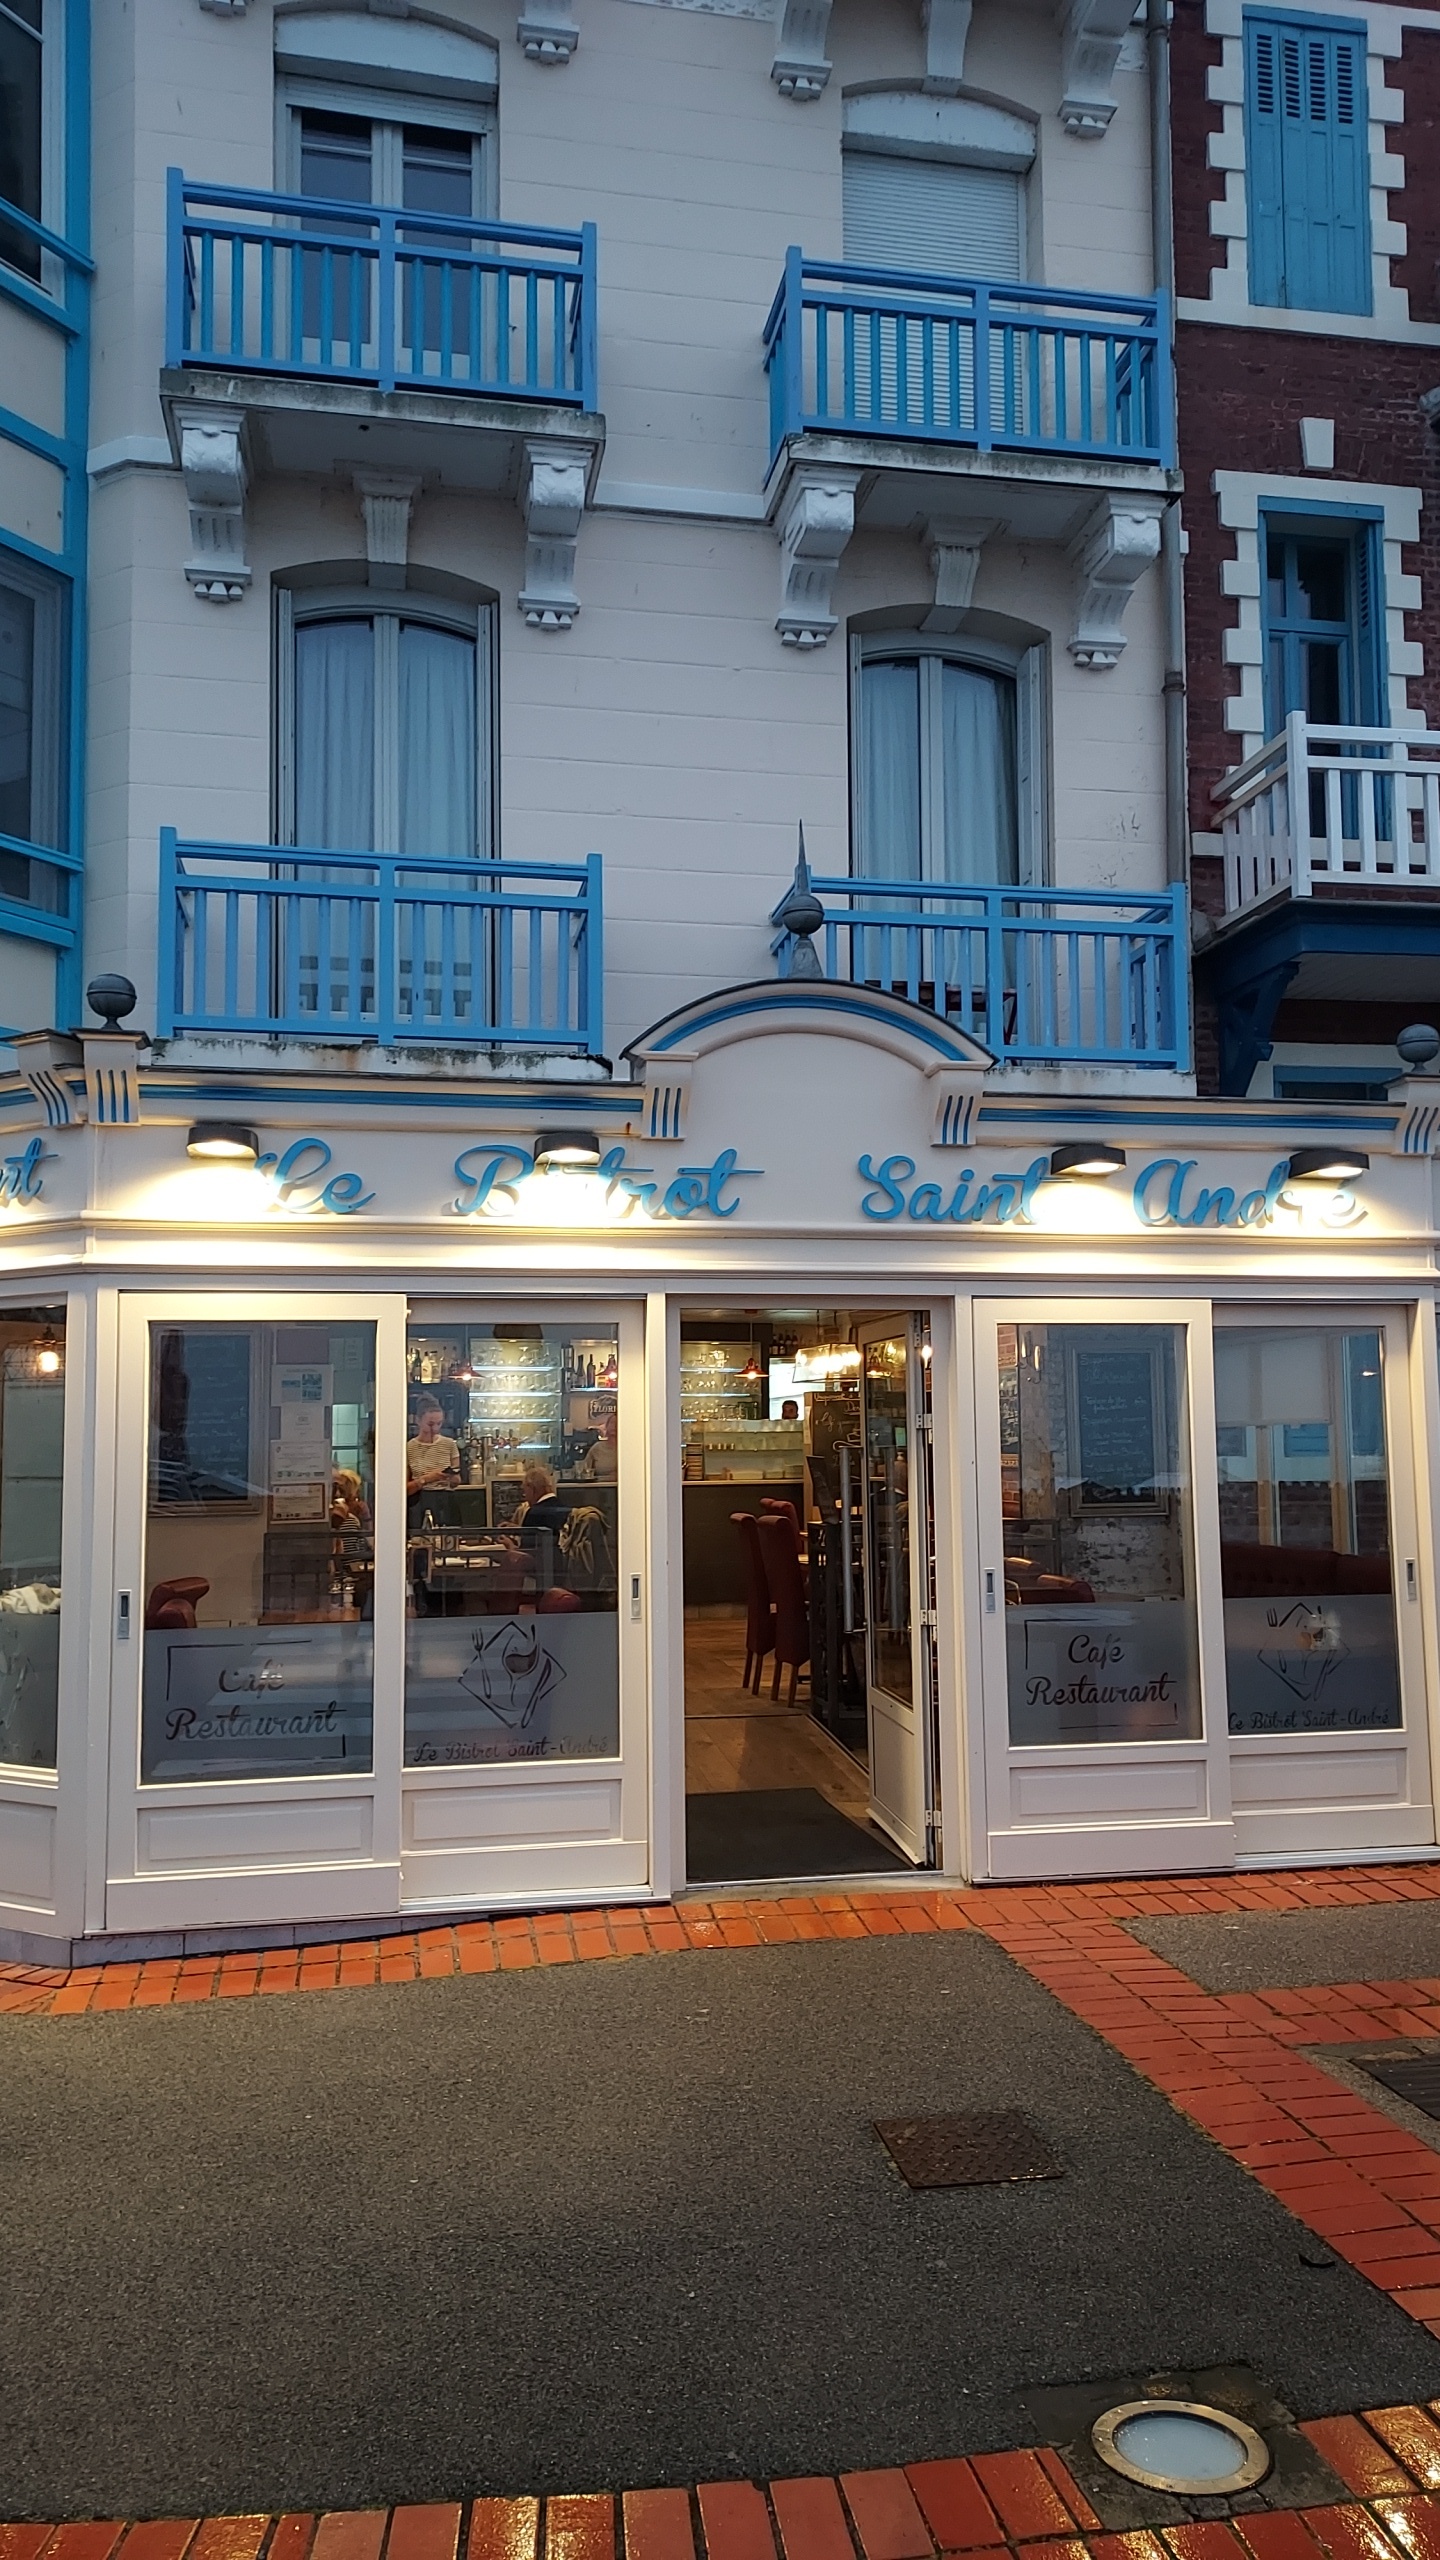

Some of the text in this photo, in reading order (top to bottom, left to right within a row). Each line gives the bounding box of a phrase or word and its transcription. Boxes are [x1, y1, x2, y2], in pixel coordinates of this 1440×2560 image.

[253, 1137, 1369, 1227] Le Btrot Saint Andé
[1068, 1633, 1125, 1670] Café
[218, 1659, 285, 1699] Café
[1026, 1672, 1178, 1706] Restaurant
[165, 1700, 348, 1741] Restaurant
[1250, 1709, 1299, 1729] Bistrot
[413, 1741, 437, 1762] Le
[444, 1740, 500, 1760] Bistrot
